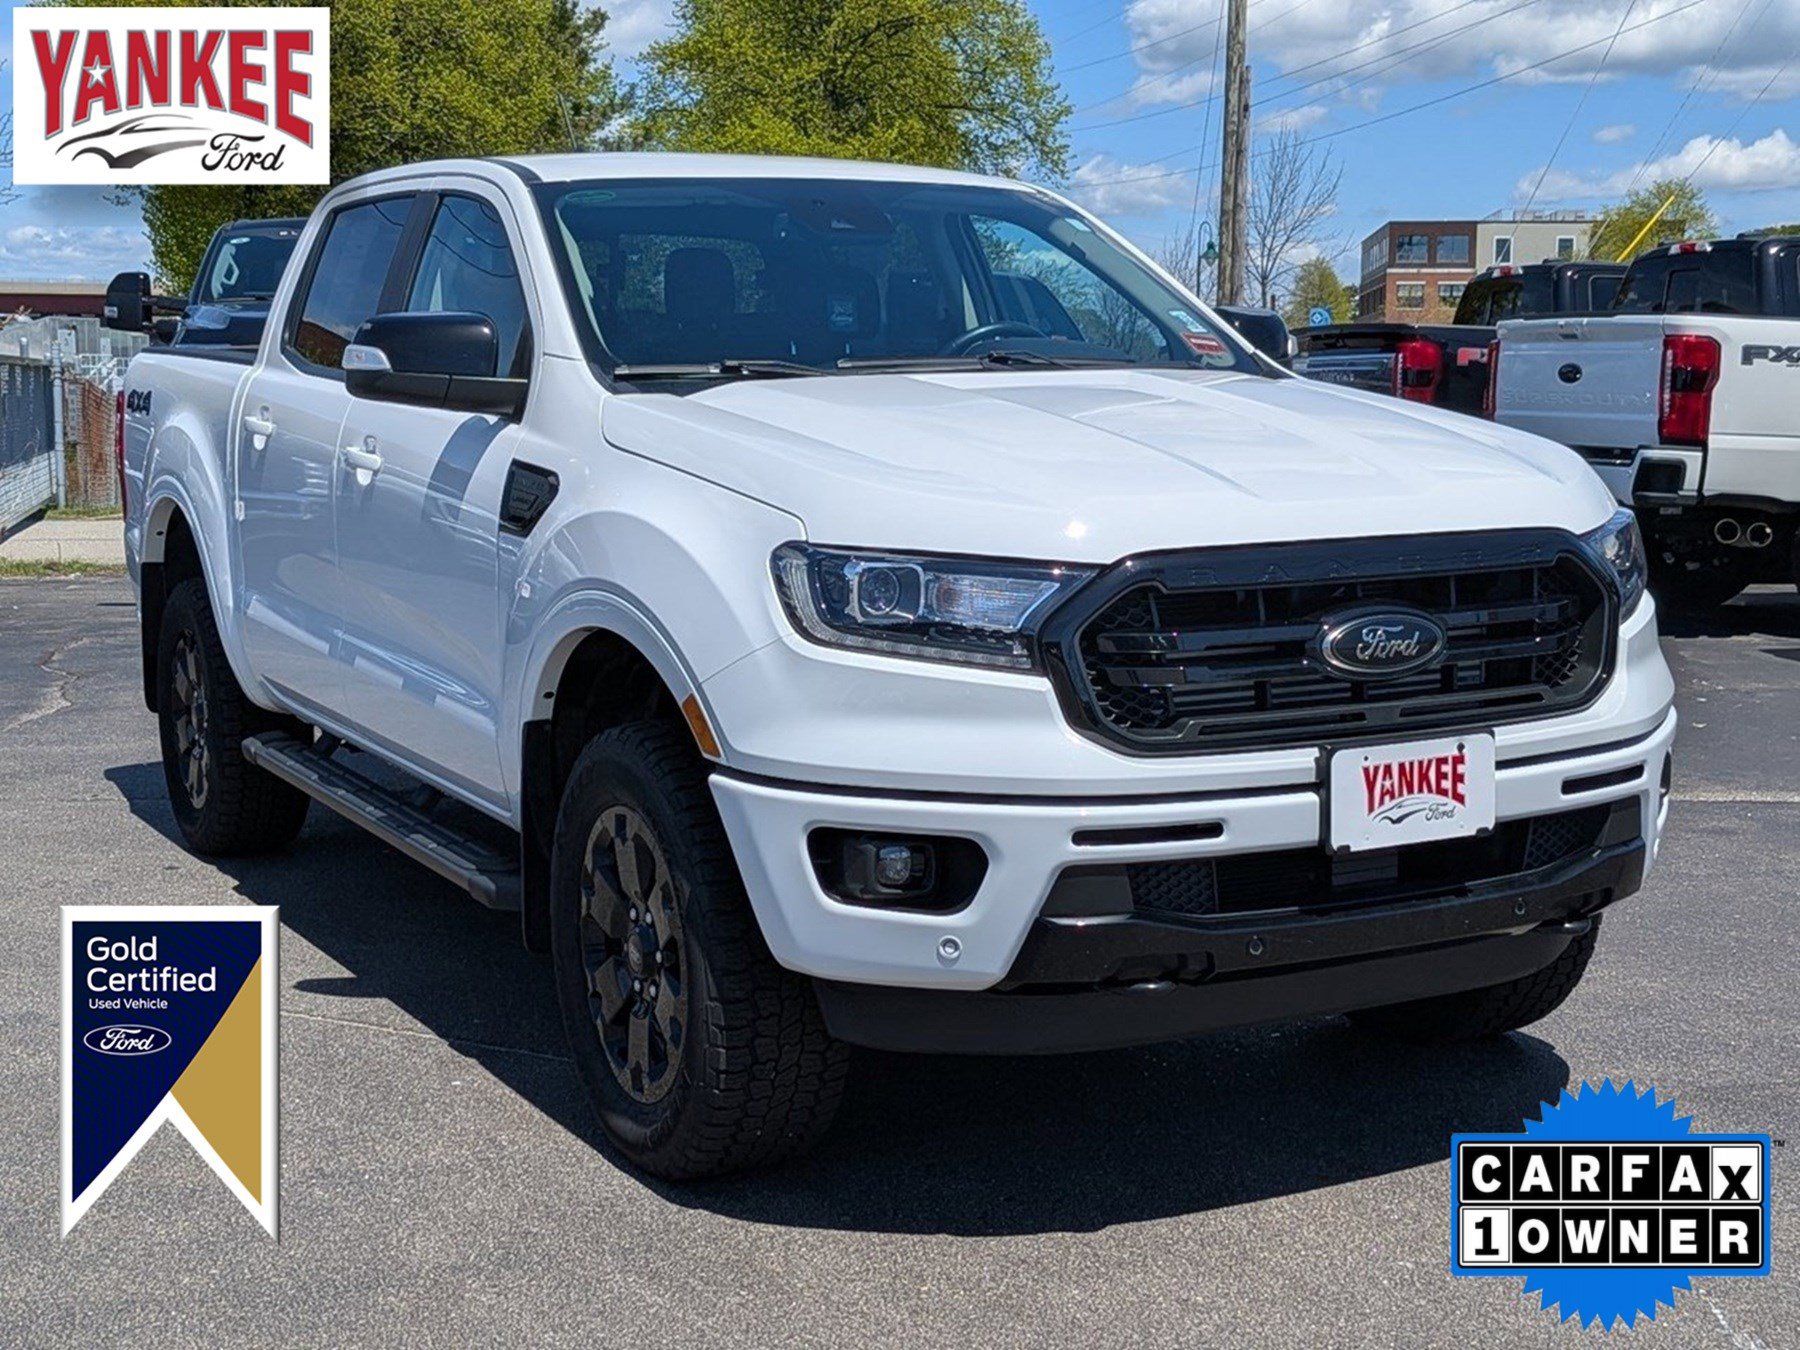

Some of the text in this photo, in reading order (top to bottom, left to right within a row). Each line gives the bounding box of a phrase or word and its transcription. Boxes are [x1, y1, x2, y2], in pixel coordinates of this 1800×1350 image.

[127, 389, 152, 416] 4X4
[1356, 625, 1420, 660] Ford
[1362, 752, 1467, 816] YANKEE
[1425, 803, 1457, 822] Ford
